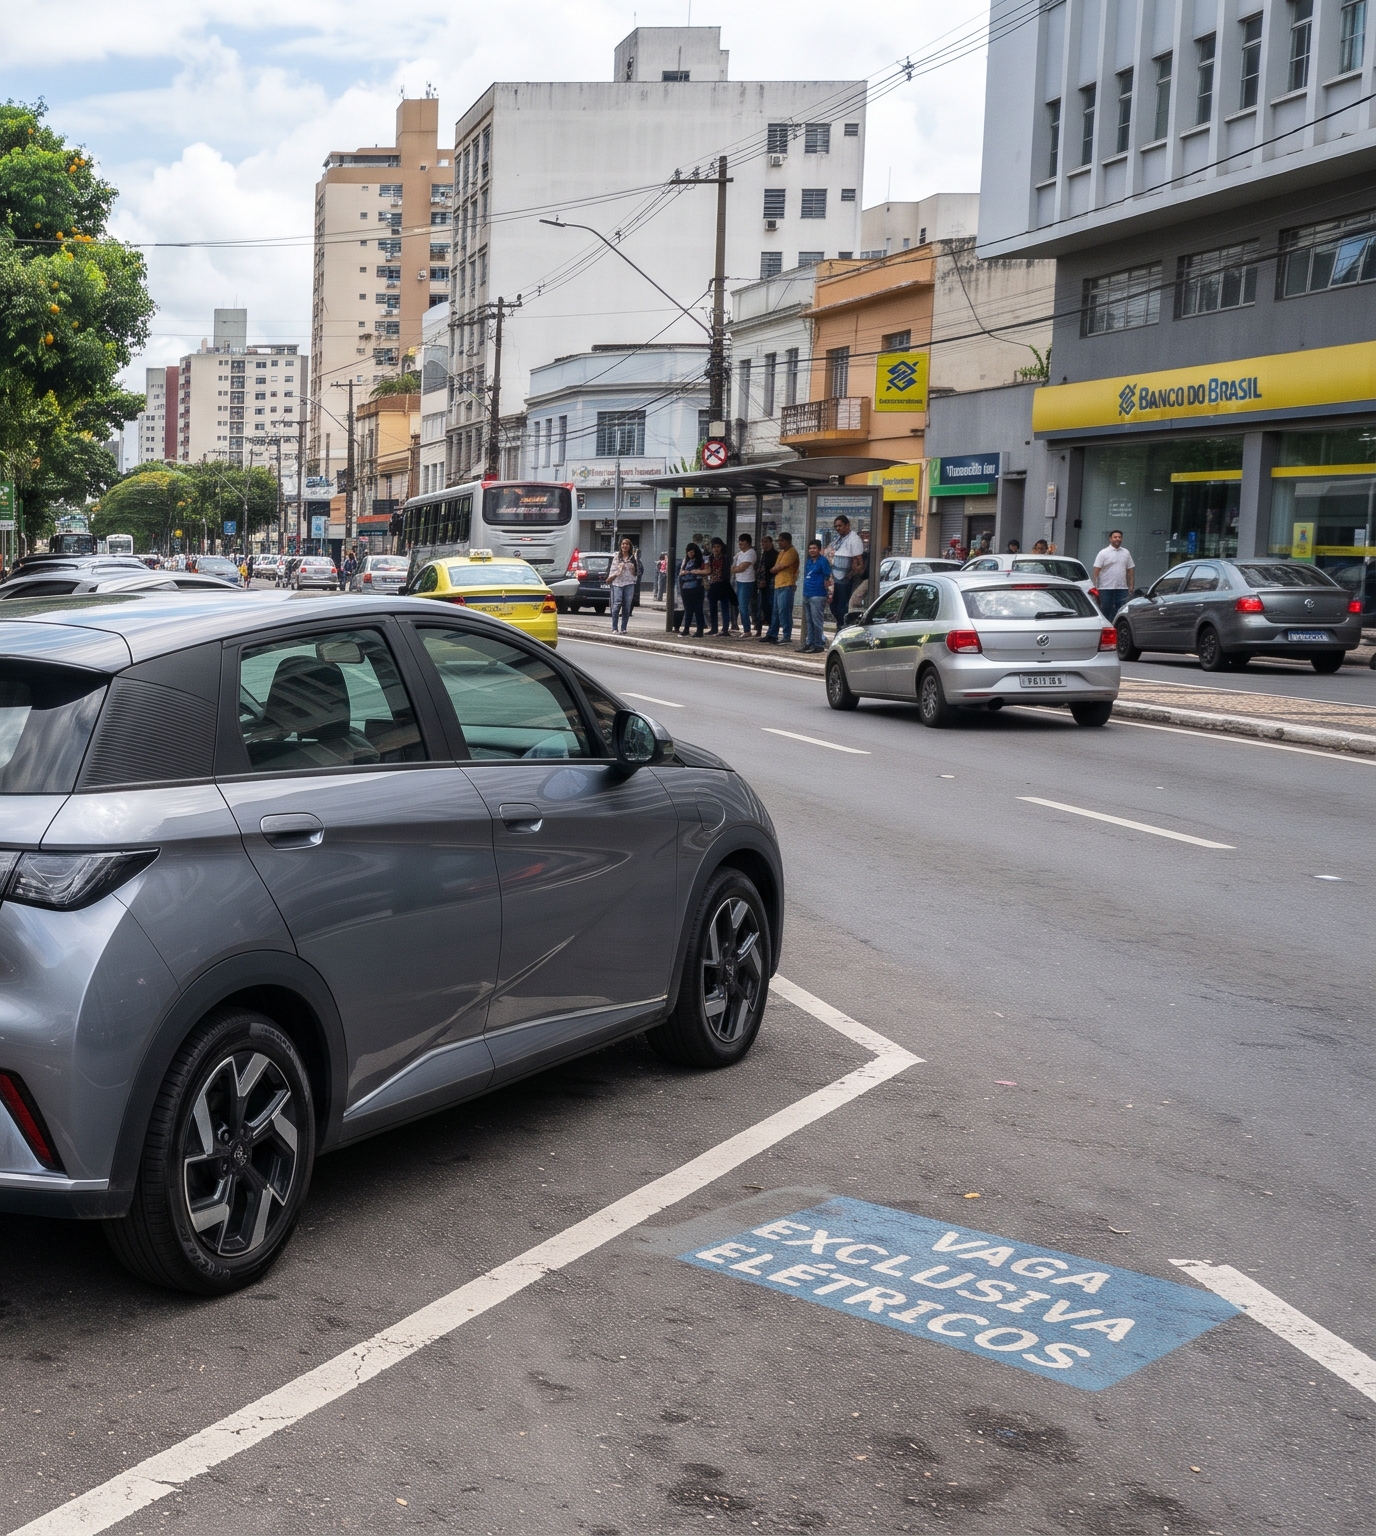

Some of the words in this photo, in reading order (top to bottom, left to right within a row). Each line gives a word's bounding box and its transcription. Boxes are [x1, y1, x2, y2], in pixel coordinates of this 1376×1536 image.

[1138, 387, 1185, 411] BANCO
[1187, 383, 1206, 406] DO
[1208, 377, 1263, 404] BRASIL
[694, 1241, 1091, 1370] ELÉTRICOS
[750, 1219, 1137, 1343] EXCLUSIVA
[930, 1230, 1113, 1295] VAGA
